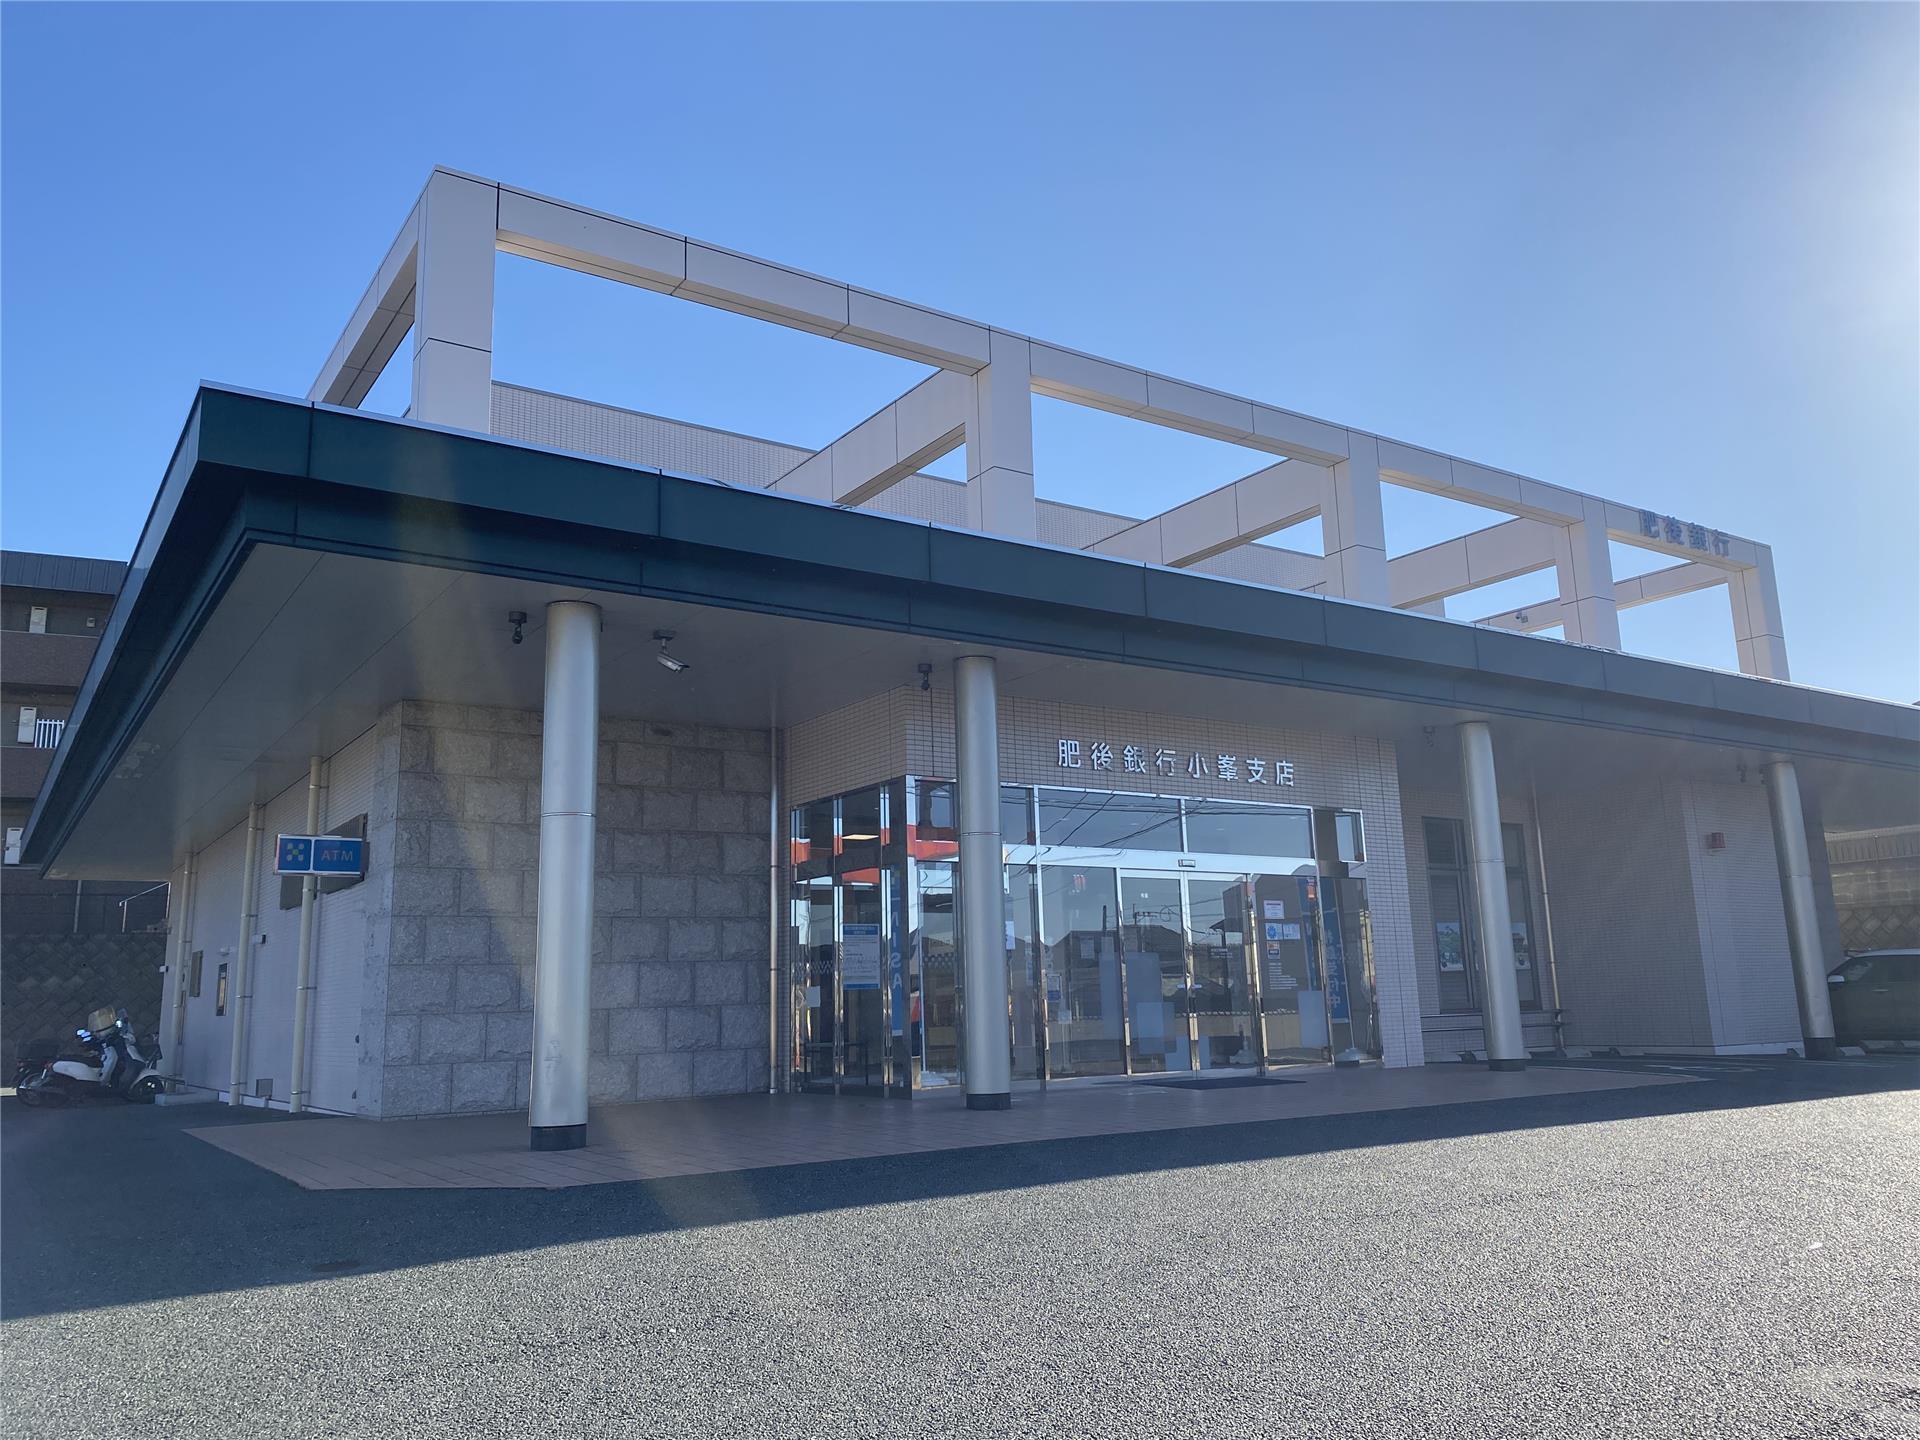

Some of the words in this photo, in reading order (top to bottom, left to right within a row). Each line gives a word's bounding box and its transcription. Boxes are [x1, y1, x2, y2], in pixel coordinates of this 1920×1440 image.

[1642, 511, 1729, 556] 肥後銀行
[1058, 739, 1294, 787] 肥後銀行小峯支店
[321, 850, 353, 862] ATM
